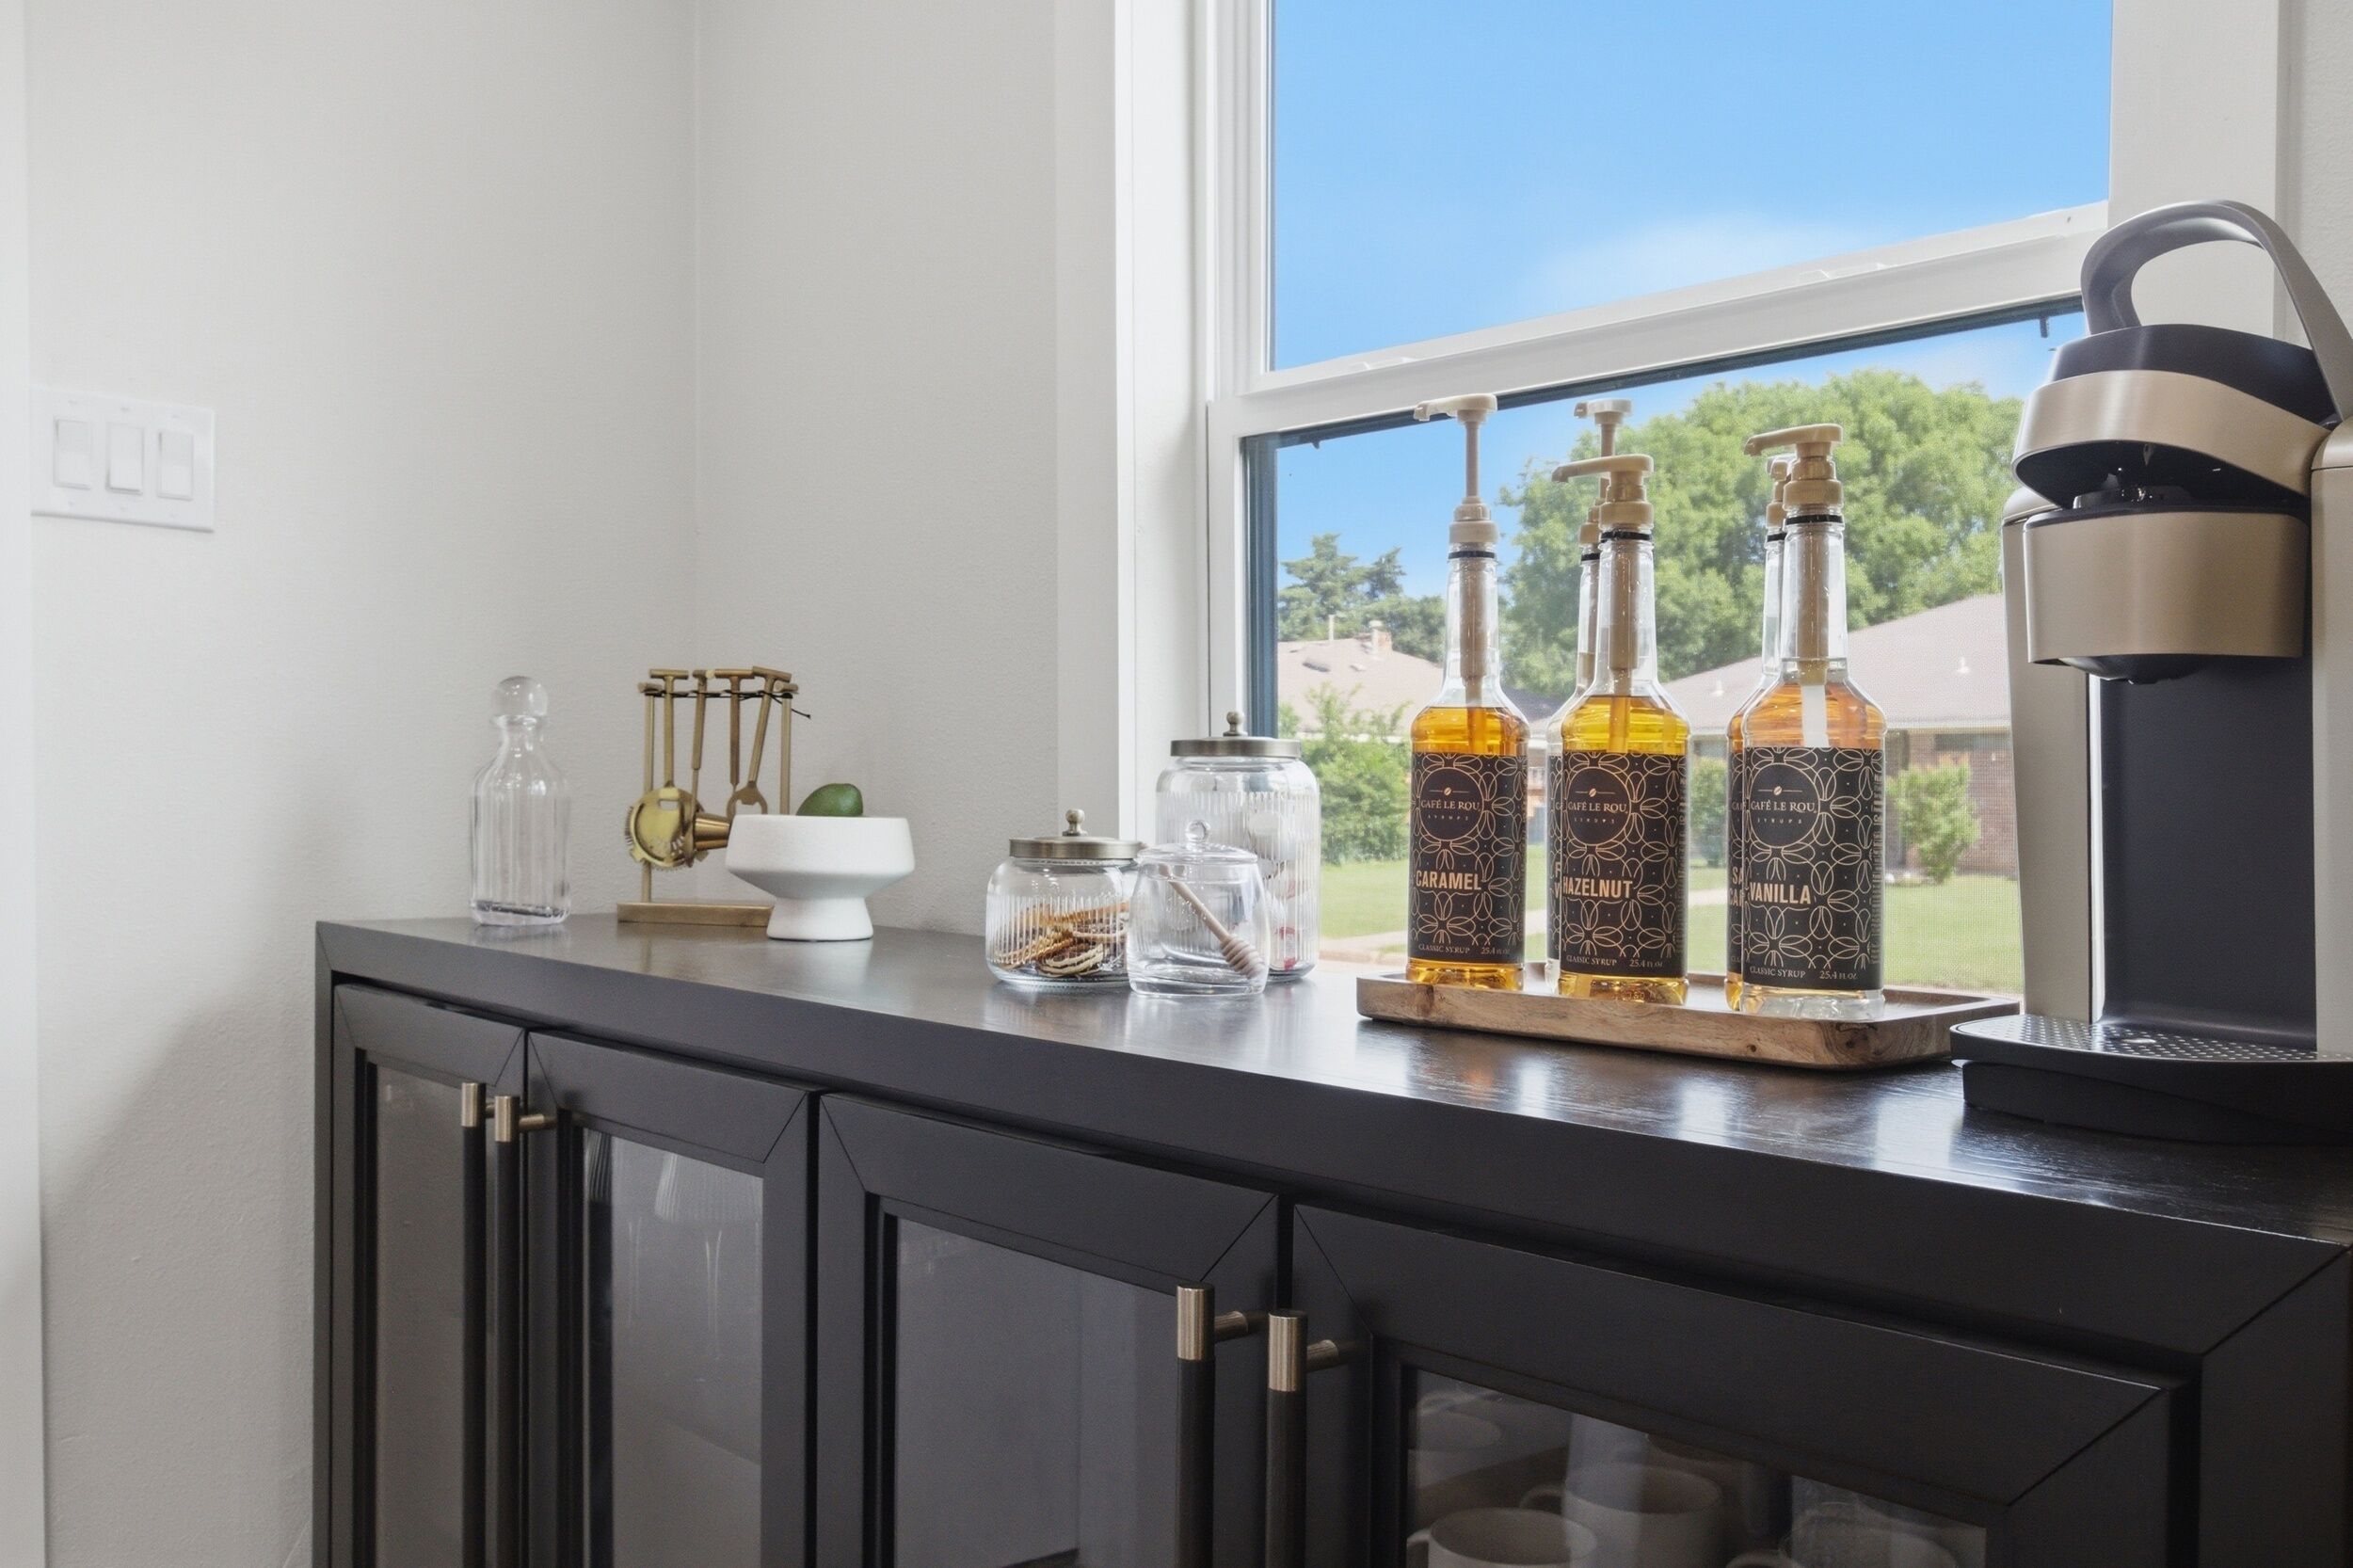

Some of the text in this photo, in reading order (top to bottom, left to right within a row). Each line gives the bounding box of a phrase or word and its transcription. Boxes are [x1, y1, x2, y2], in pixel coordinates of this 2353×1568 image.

[1421, 799, 1442, 809] CAFÉ
[1444, 801, 1456, 810] LE
[1567, 801, 1587, 811] CAFÉ
[1589, 803, 1601, 811] LE
[1751, 799, 1771, 810] CAFÉ
[1773, 801, 1786, 811] LE
[1416, 870, 1482, 890] CARAMEL
[1562, 875, 1633, 899] HAZELNUT
[1750, 882, 1812, 904] VANILLA
[1418, 943, 1470, 954] CLASSIC SYRUP
[1591, 956, 1618, 967] SYRUP
[1629, 958, 1645, 968] 25.4
[1750, 966, 1806, 979] CLASSIC SYRUP
[1819, 970, 1837, 980] 25.4
